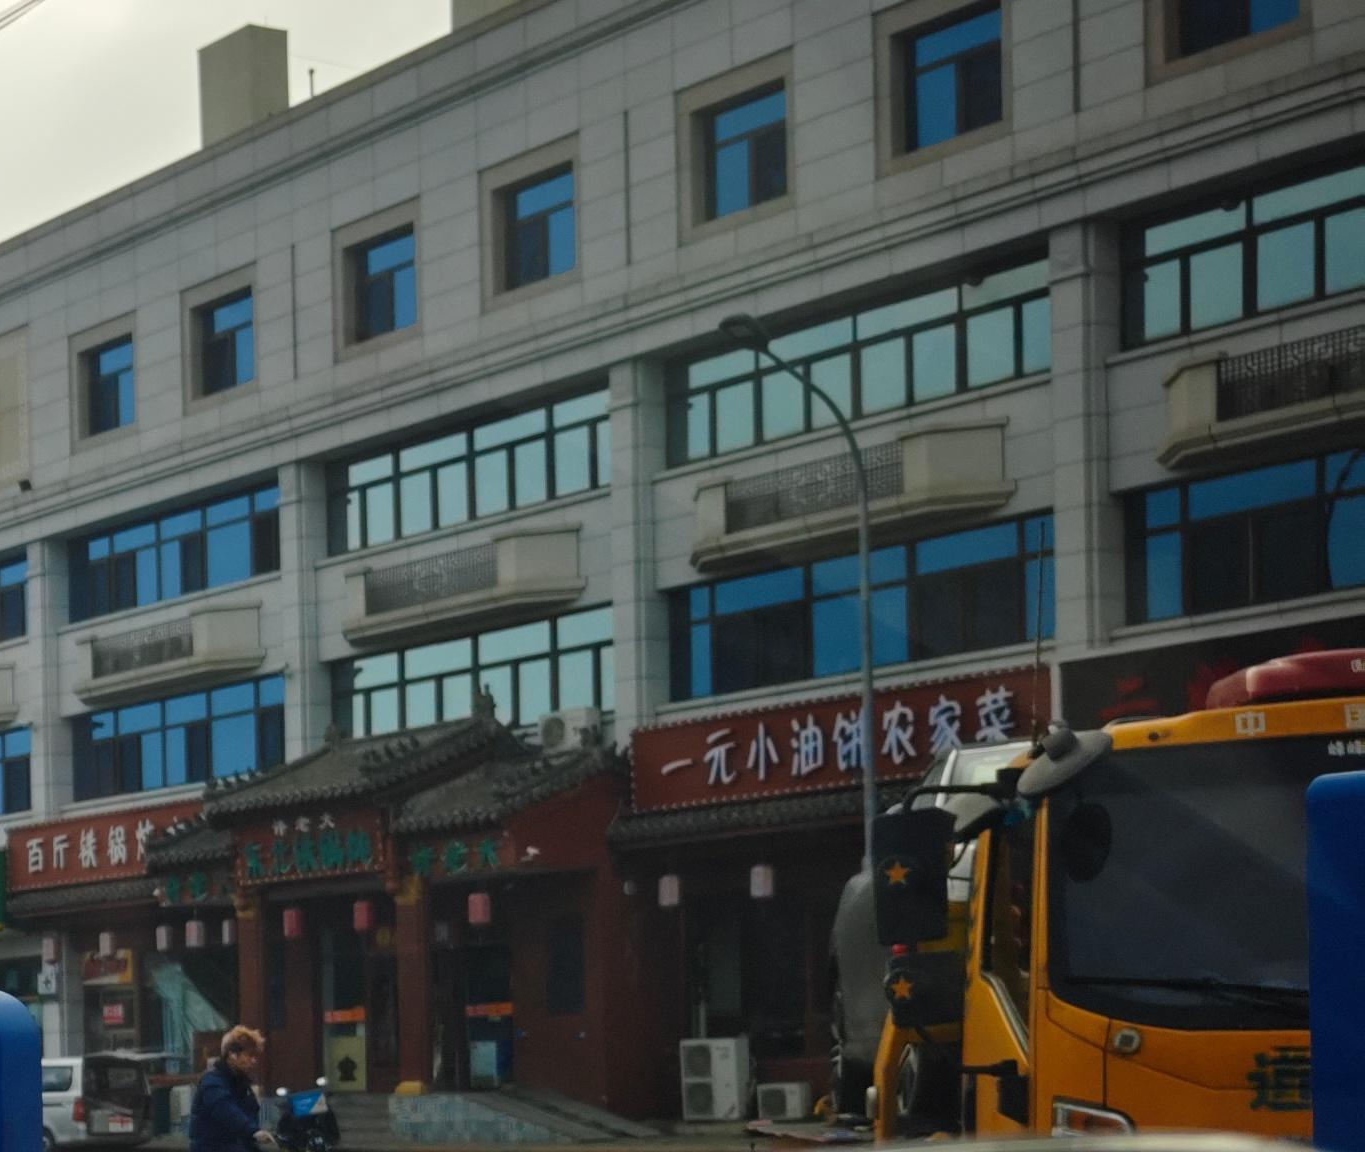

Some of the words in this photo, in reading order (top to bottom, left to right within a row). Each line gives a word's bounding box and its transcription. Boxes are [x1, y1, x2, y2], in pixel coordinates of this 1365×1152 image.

[661, 687, 1015, 786] 一元小油饼农家菜
